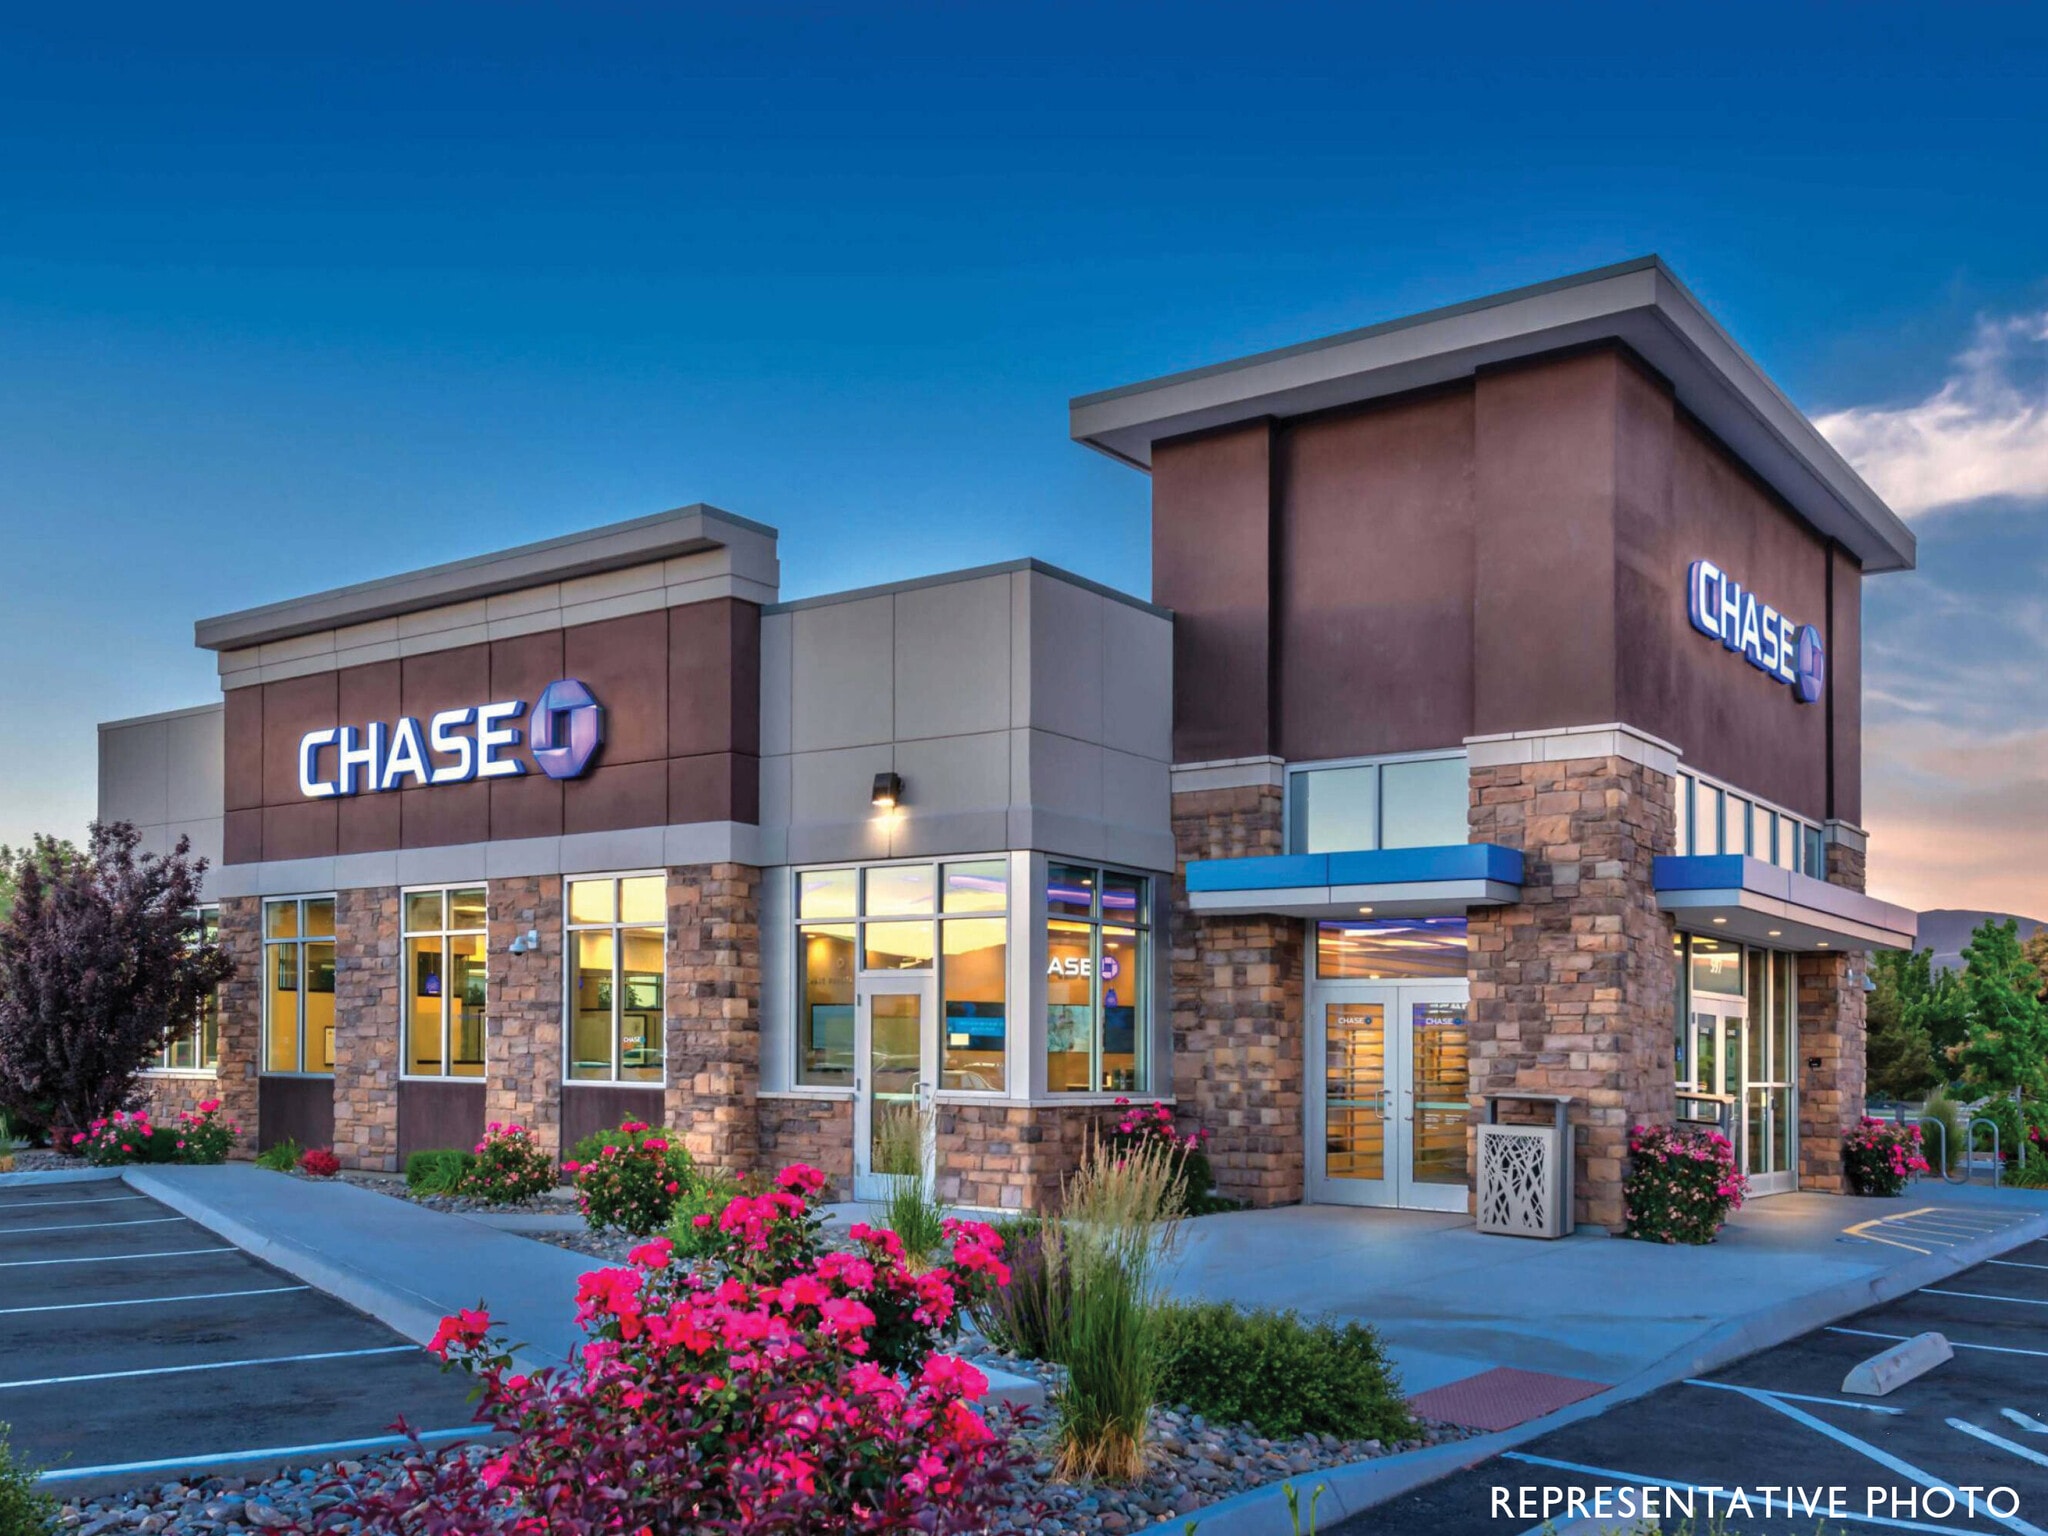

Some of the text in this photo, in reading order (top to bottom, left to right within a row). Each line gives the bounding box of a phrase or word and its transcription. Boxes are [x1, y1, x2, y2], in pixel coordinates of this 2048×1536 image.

[1690, 561, 1796, 684] CHASE
[299, 700, 525, 797] CHASE
[1047, 956, 1090, 976] ASE
